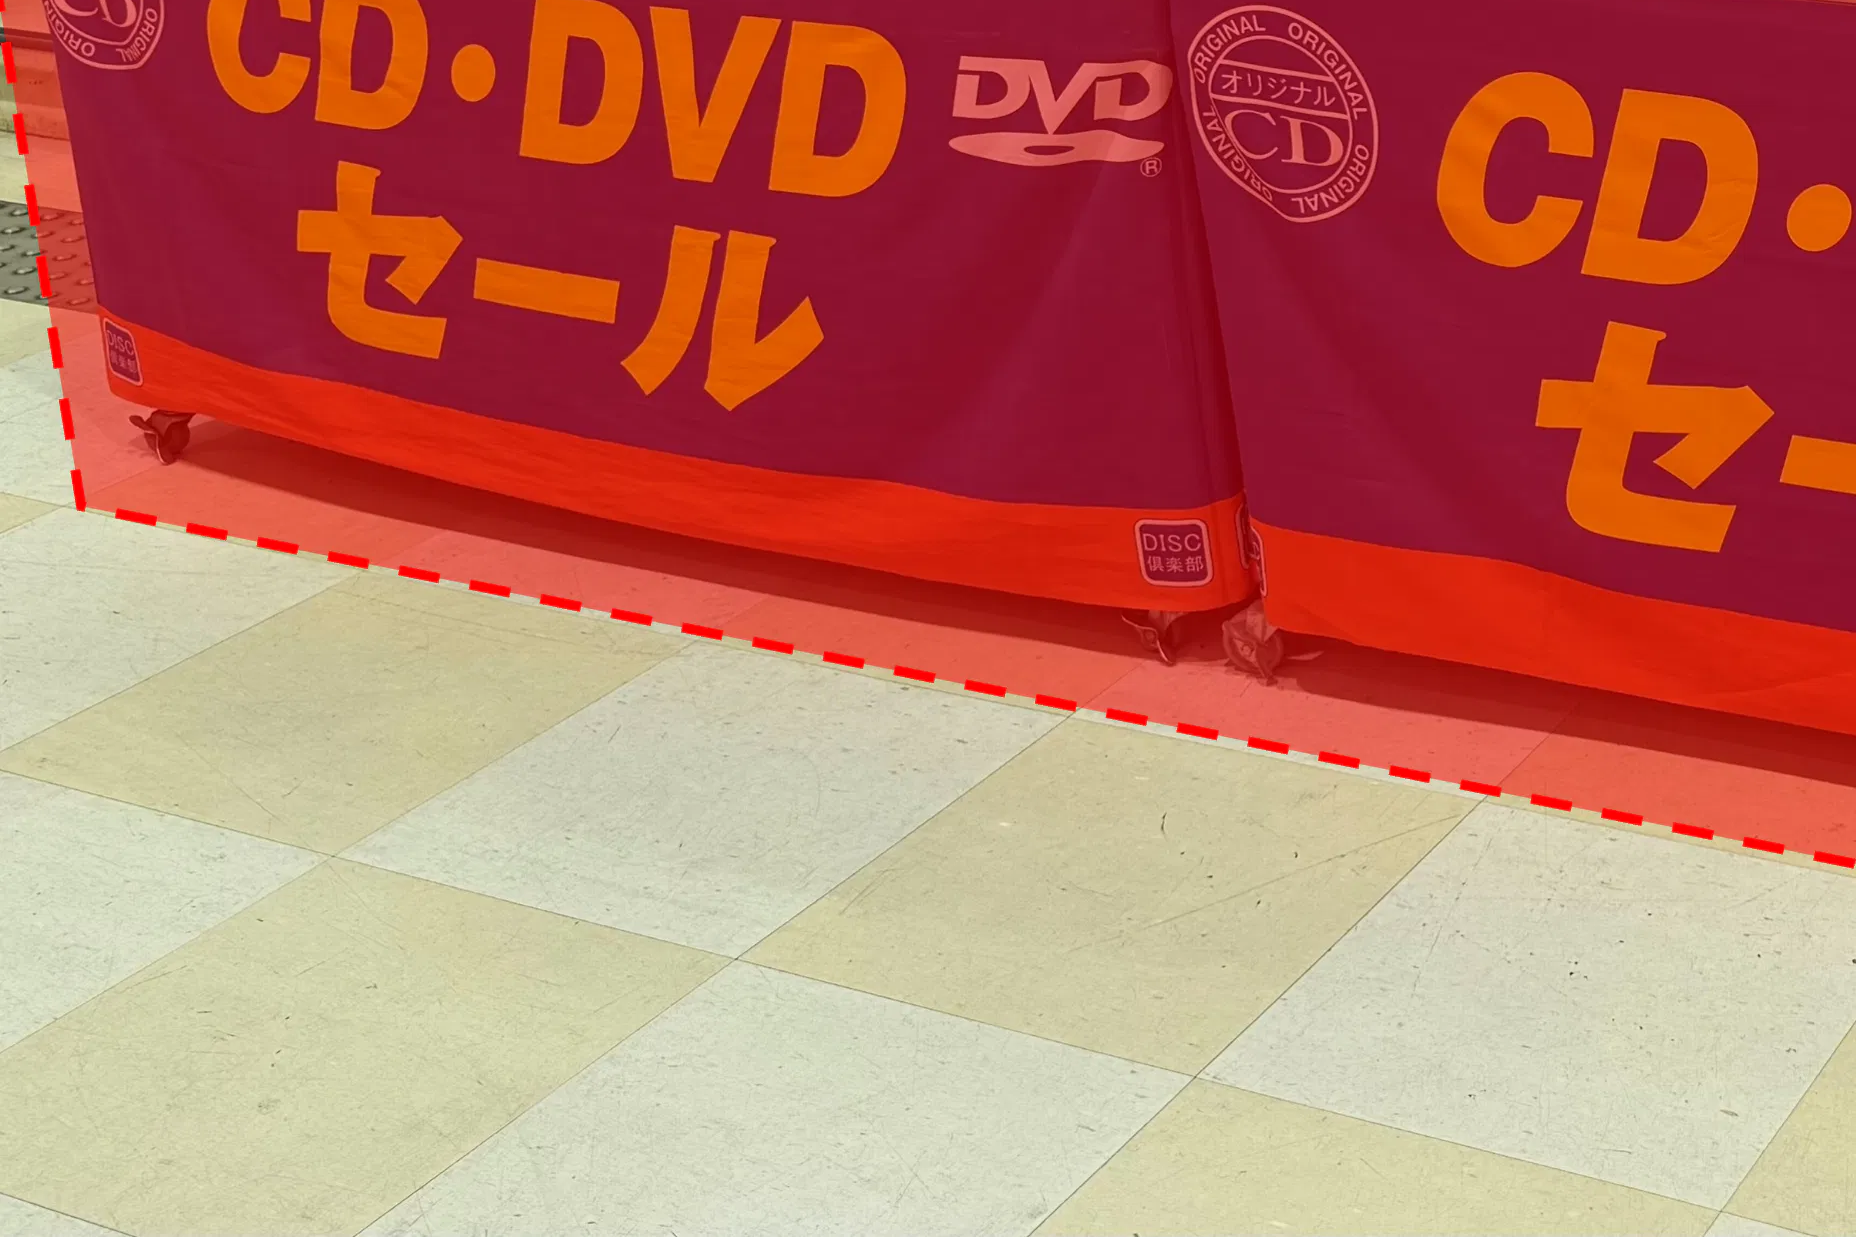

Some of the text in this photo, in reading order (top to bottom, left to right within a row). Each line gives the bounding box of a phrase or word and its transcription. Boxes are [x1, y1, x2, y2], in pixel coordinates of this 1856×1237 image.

[952, 55, 1173, 136] DVD
[1194, 14, 1369, 120] ORIGINAL ORIGINAL
[1220, 69, 1337, 108] オリジナル
[1224, 108, 1343, 168] CD
[296, 160, 825, 412] セール
[1142, 530, 1202, 553] DISC
[1145, 553, 1205, 575] 倶楽部
